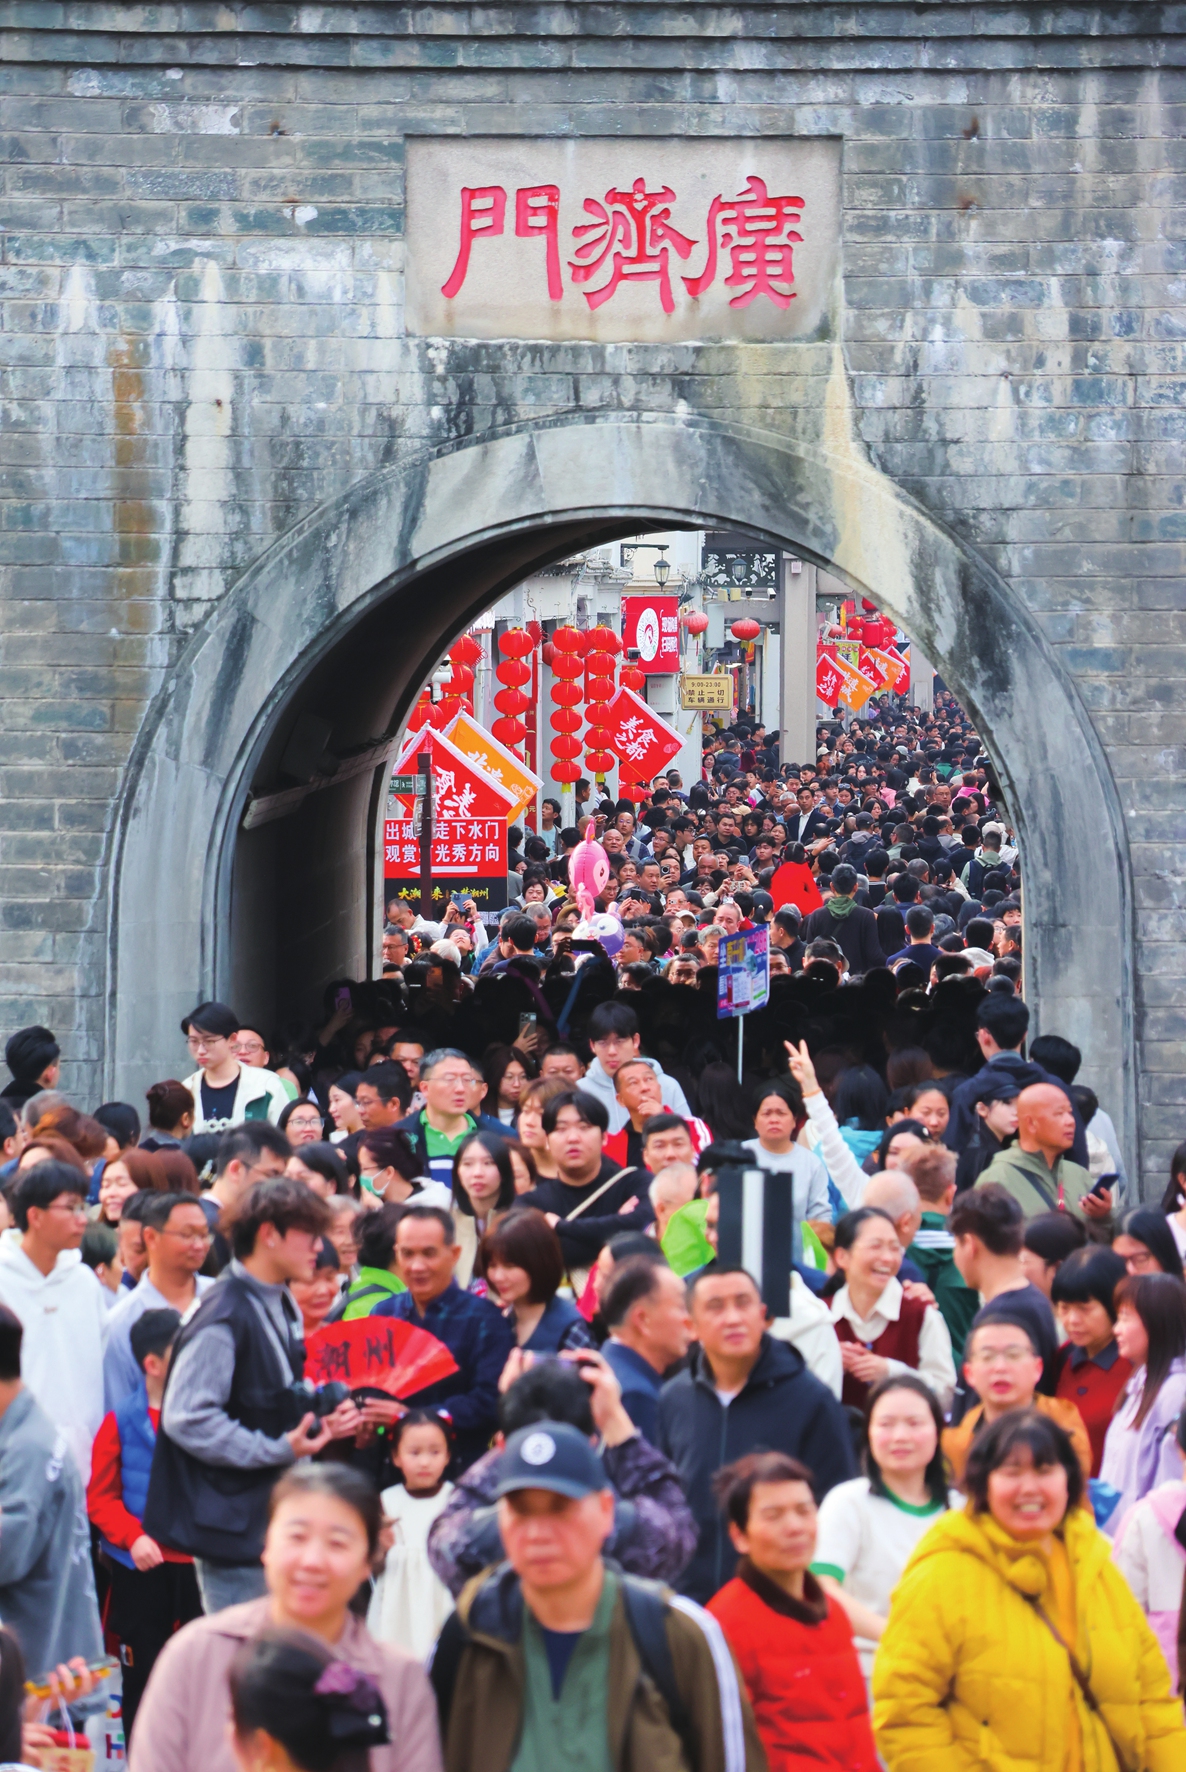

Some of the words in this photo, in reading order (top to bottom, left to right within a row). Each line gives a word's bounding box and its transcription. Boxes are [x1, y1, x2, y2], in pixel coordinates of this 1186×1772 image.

[386, 821, 500, 840] 出城走下水门
[385, 843, 500, 863] 观赏光秀方向
